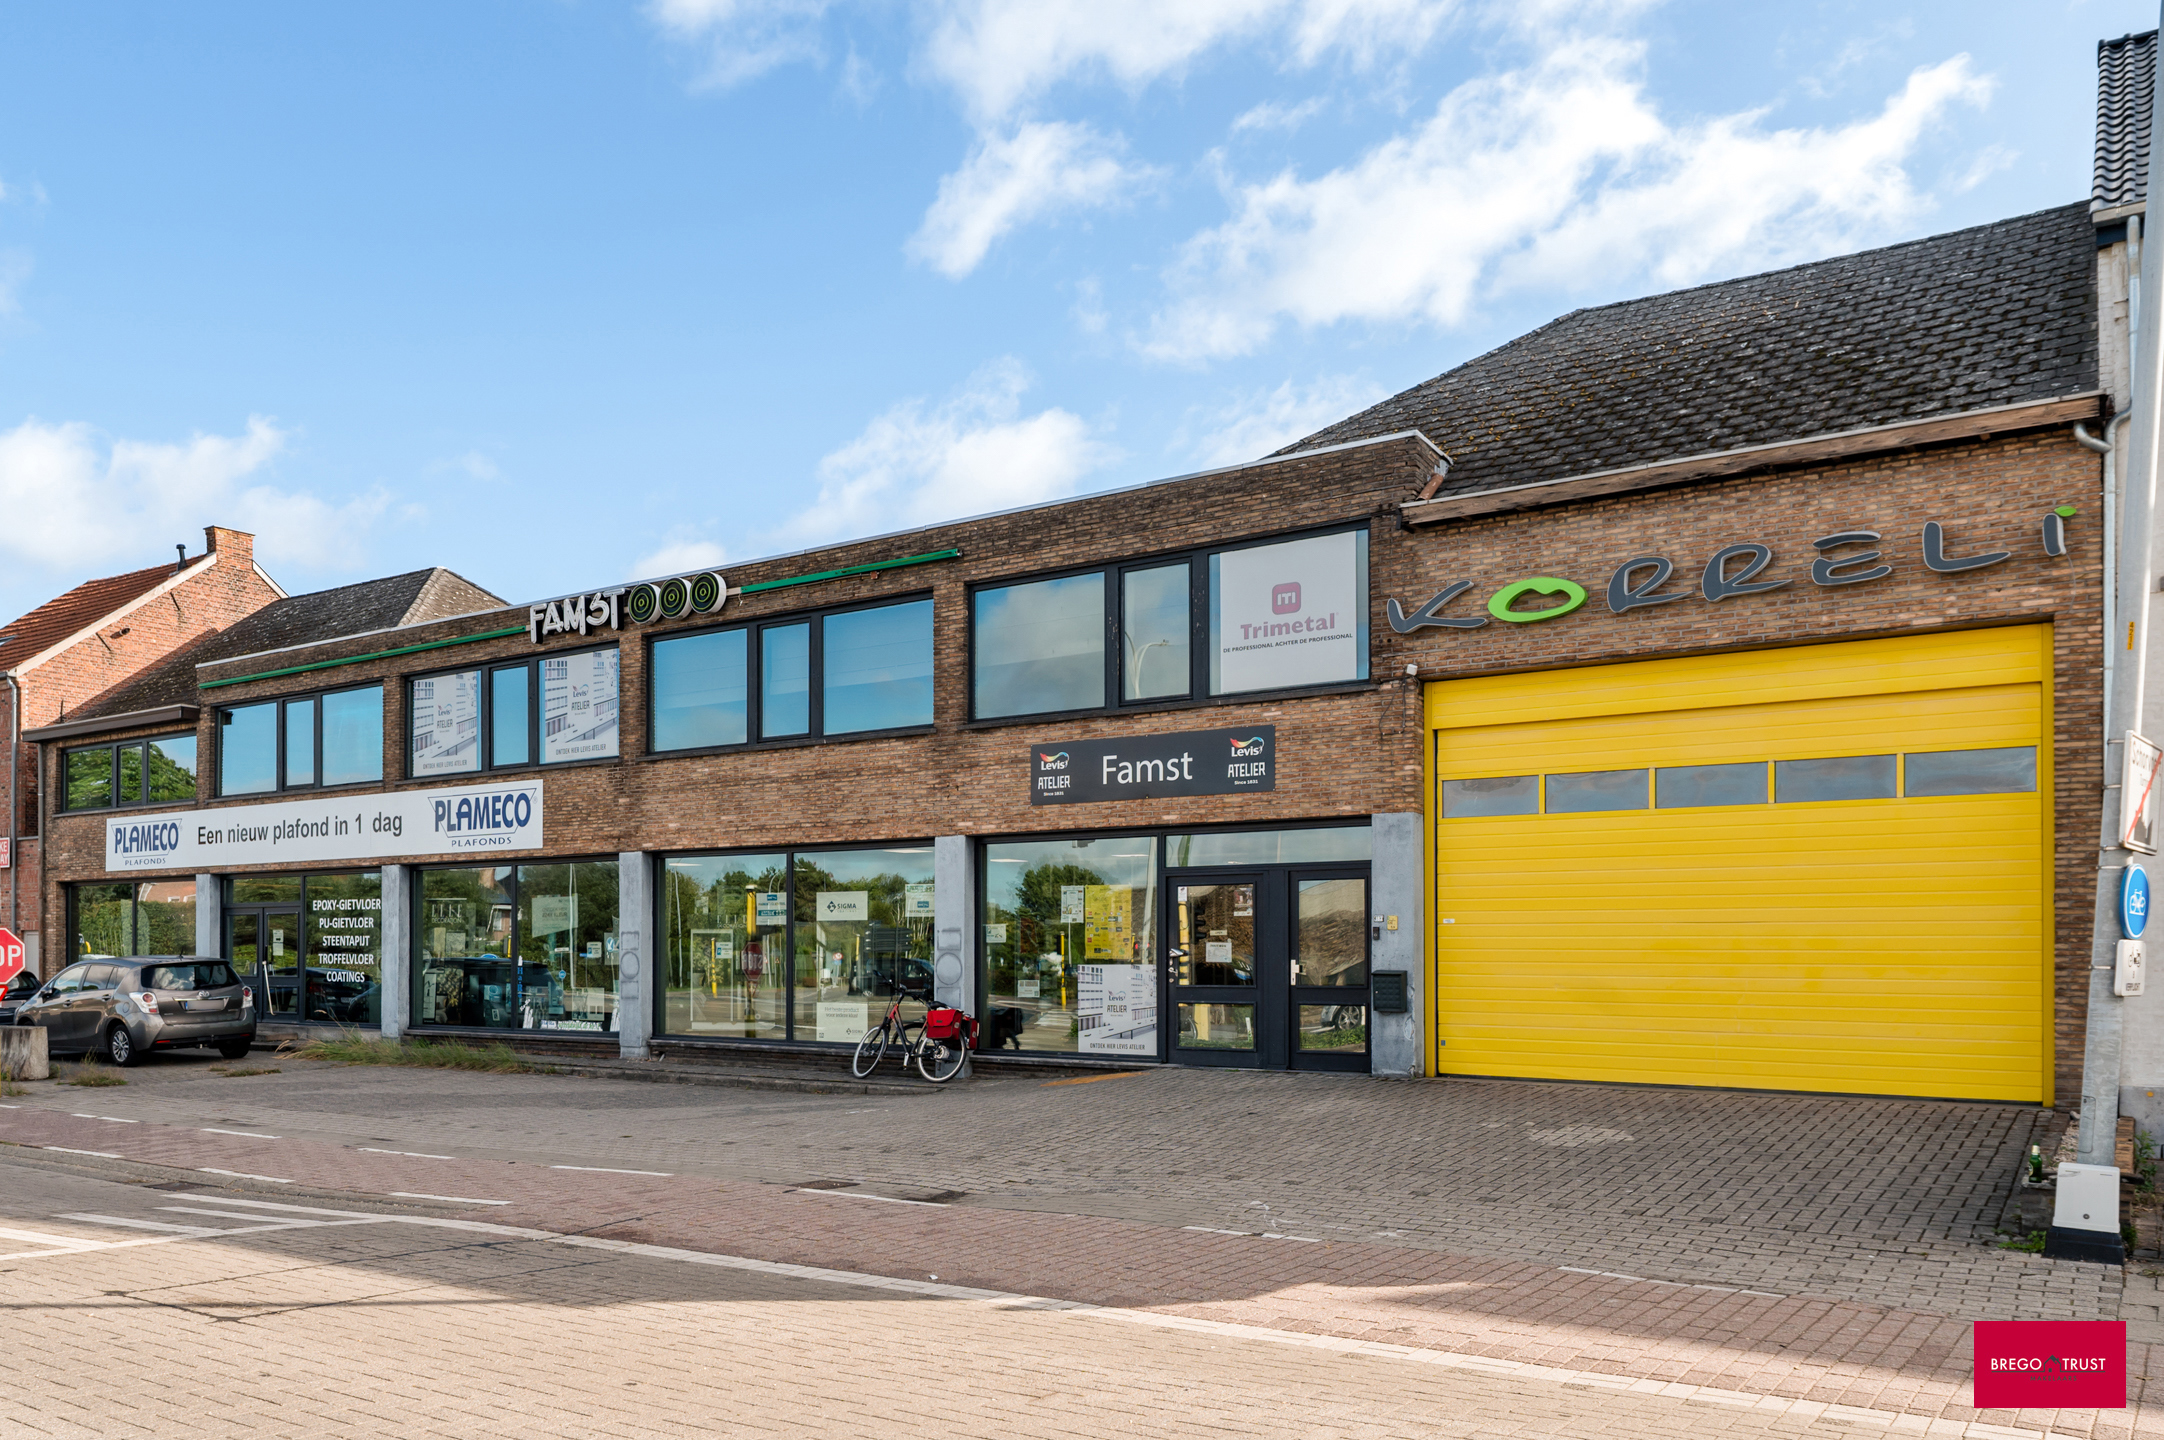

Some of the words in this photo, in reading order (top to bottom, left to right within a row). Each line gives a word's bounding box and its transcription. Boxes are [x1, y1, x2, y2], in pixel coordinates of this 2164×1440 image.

[530, 588, 628, 644] FAMST
[1240, 612, 1335, 640] Trimetal
[1232, 642, 1274, 652] PROFESSIONAL
[1275, 639, 1298, 647] ACHTER
[1308, 633, 1353, 643] PROFESSIONAL
[571, 700, 590, 711] ATELIER
[437, 719, 453, 729] ATELIER
[1231, 746, 1259, 757] Levis
[1041, 760, 1065, 770] Levis
[1102, 751, 1193, 785] Famst
[1227, 762, 1266, 778] ATELIER
[1038, 775, 1070, 790] ATELIER
[435, 792, 531, 832] PLAMECO
[198, 826, 223, 845] Een
[227, 823, 268, 843] nieuw
[273, 816, 329, 844] plafond
[335, 815, 348, 836] in
[355, 813, 362, 834] 1
[372, 811, 402, 837] dag
[114, 822, 179, 854] PLAMECO
[451, 837, 512, 847] PLAFONDS
[125, 857, 166, 866] PLAFONDS
[312, 898, 381, 911] EPOXY-GIETVLOER
[319, 917, 374, 929] PU-GIETVLOER
[322, 935, 370, 946] STEENTAPIJT
[318, 953, 374, 965] TROFFELVLOER
[326, 971, 365, 982] COATINGS
[1107, 1004, 1127, 1013] ATELIER
